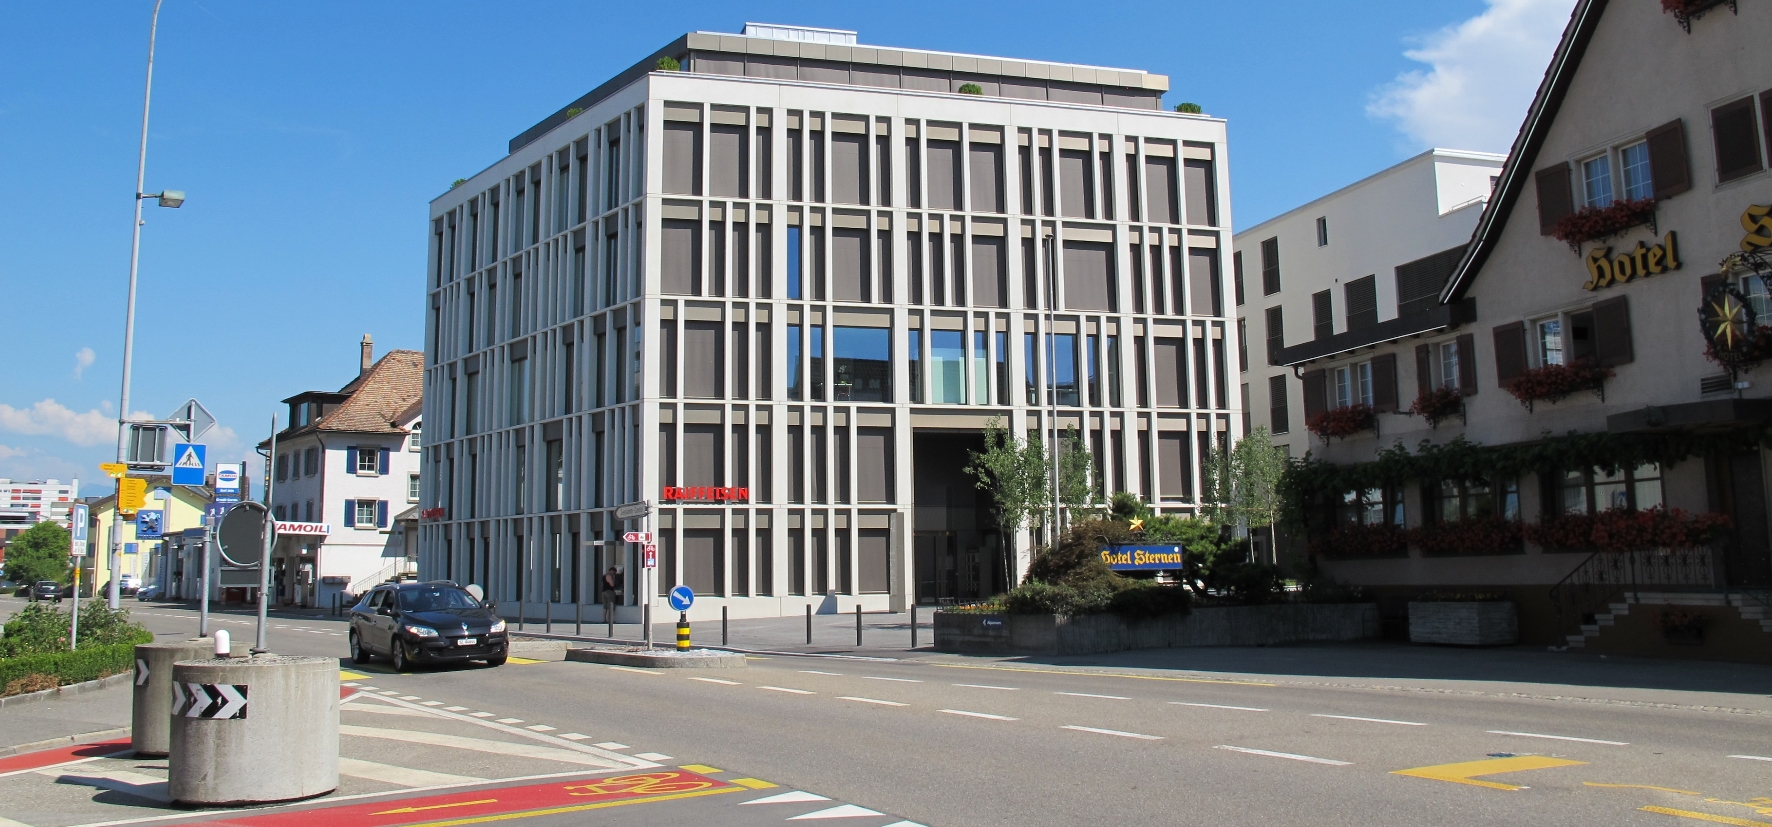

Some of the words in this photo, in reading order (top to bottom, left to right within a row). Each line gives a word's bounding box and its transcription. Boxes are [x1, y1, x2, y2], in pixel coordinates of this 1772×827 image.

[1582, 230, 1682, 292] Hotel
[1717, 350, 1745, 362] HOTEL
[663, 486, 749, 500] RAIFFEISEN
[275, 522, 327, 533] AMOIL
[1101, 550, 1132, 565] Hotel
[1134, 549, 1182, 565] Sternen
